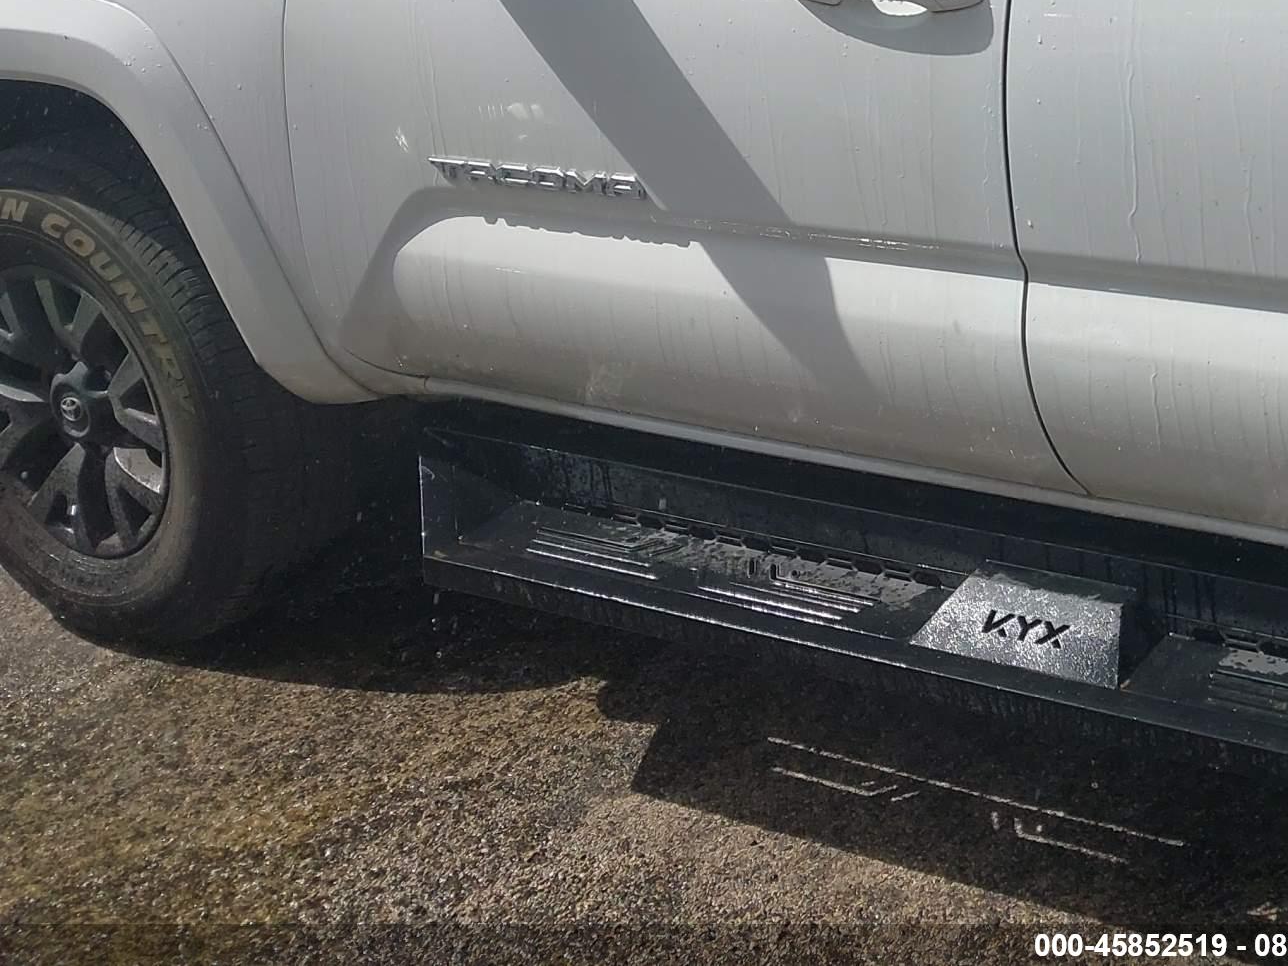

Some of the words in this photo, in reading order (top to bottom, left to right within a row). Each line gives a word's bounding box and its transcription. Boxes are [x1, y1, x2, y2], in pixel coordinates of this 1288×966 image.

[428, 155, 648, 200] TACOMA
[41, 212, 196, 414] COUNTRY
[982, 610, 1071, 649] KYX
